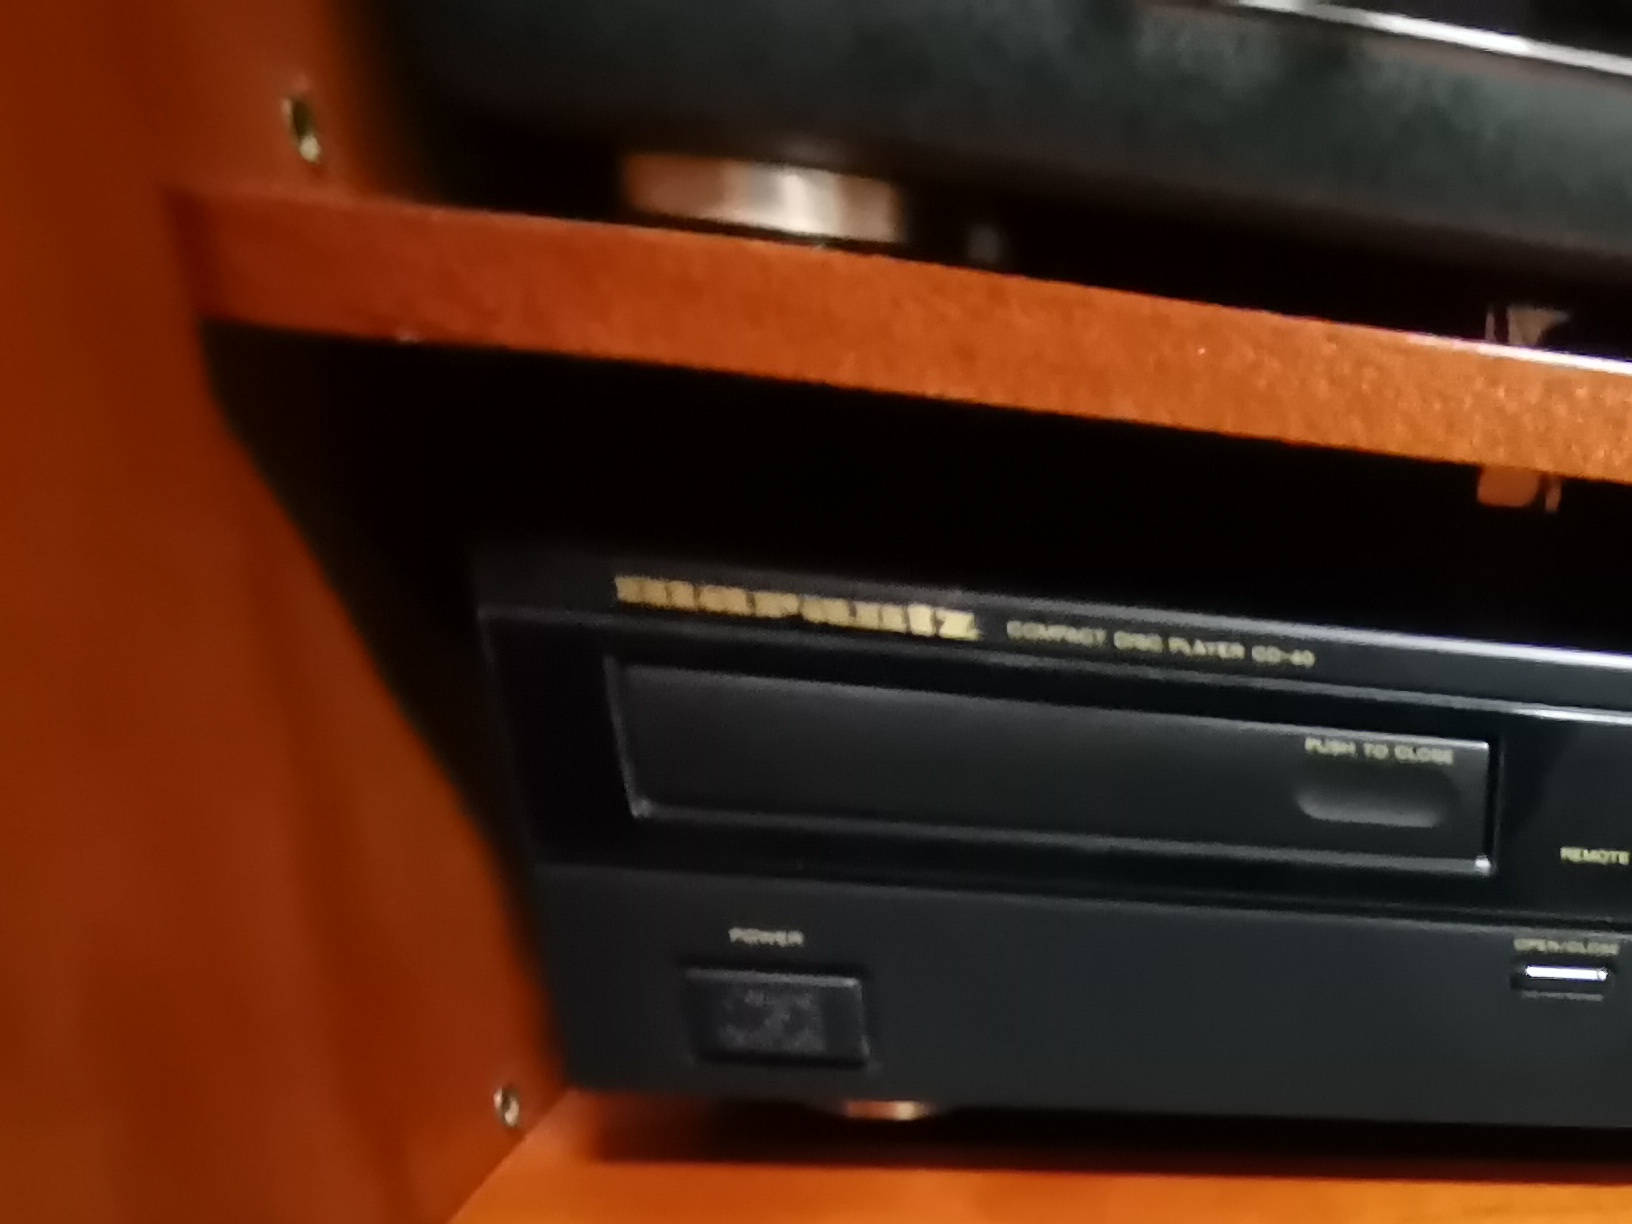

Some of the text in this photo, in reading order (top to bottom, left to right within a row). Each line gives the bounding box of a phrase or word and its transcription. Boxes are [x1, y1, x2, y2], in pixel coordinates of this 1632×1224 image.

[1006, 619, 1107, 648] COMPACT
[1113, 630, 1164, 654] DISC
[1168, 635, 1247, 661] PLAYER
[1304, 736, 1456, 766] PUSH TO CLOSE
[1560, 846, 1630, 866] REMOTE
